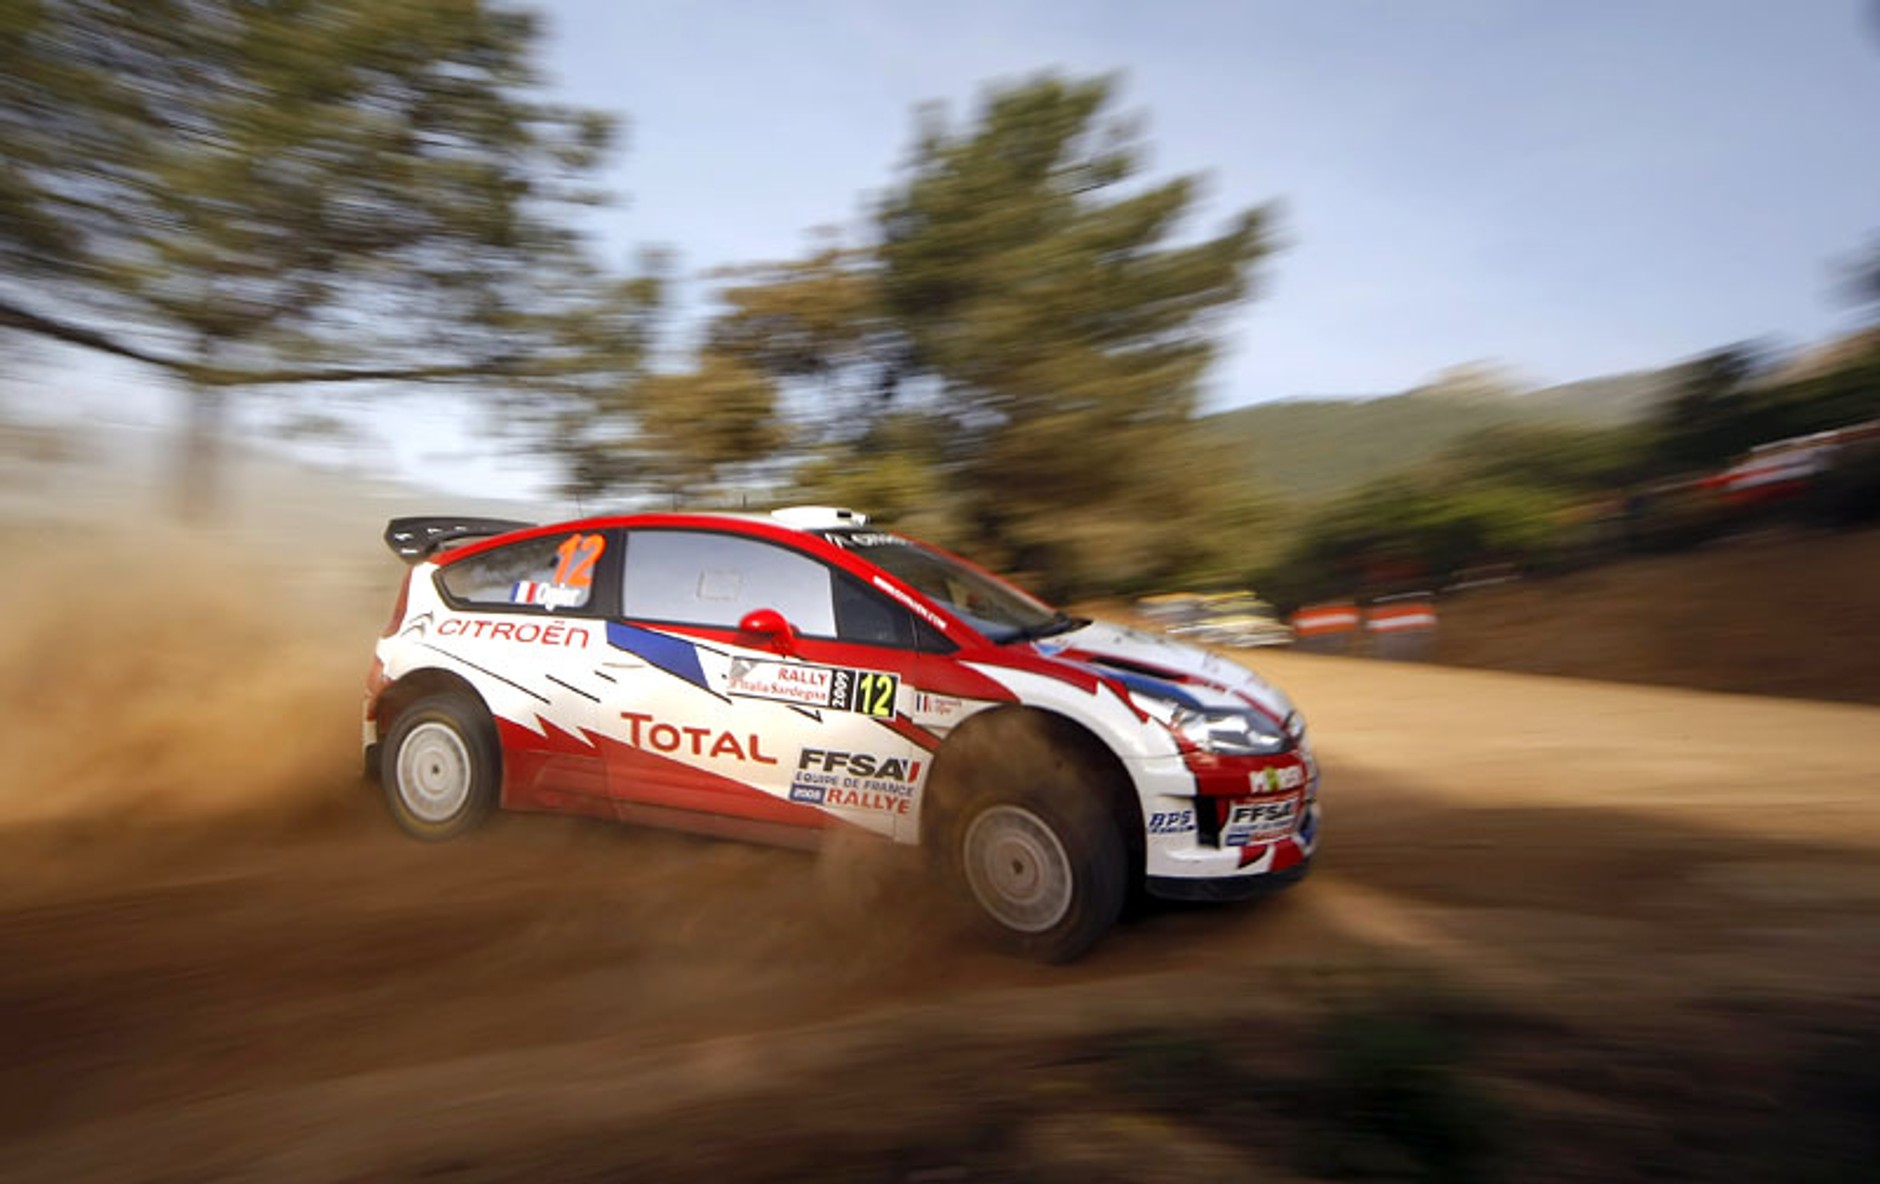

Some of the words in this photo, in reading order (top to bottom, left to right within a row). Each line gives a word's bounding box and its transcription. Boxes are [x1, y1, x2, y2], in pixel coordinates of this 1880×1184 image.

[554, 533, 606, 587] 12
[777, 667, 828, 687] RALLY
[831, 671, 850, 708] 2009
[860, 673, 894, 717] 12
[799, 748, 905, 783] FFSA
[827, 788, 912, 815] RALLYE
[843, 777, 859, 789] DE
[862, 780, 914, 797] FRANCE
